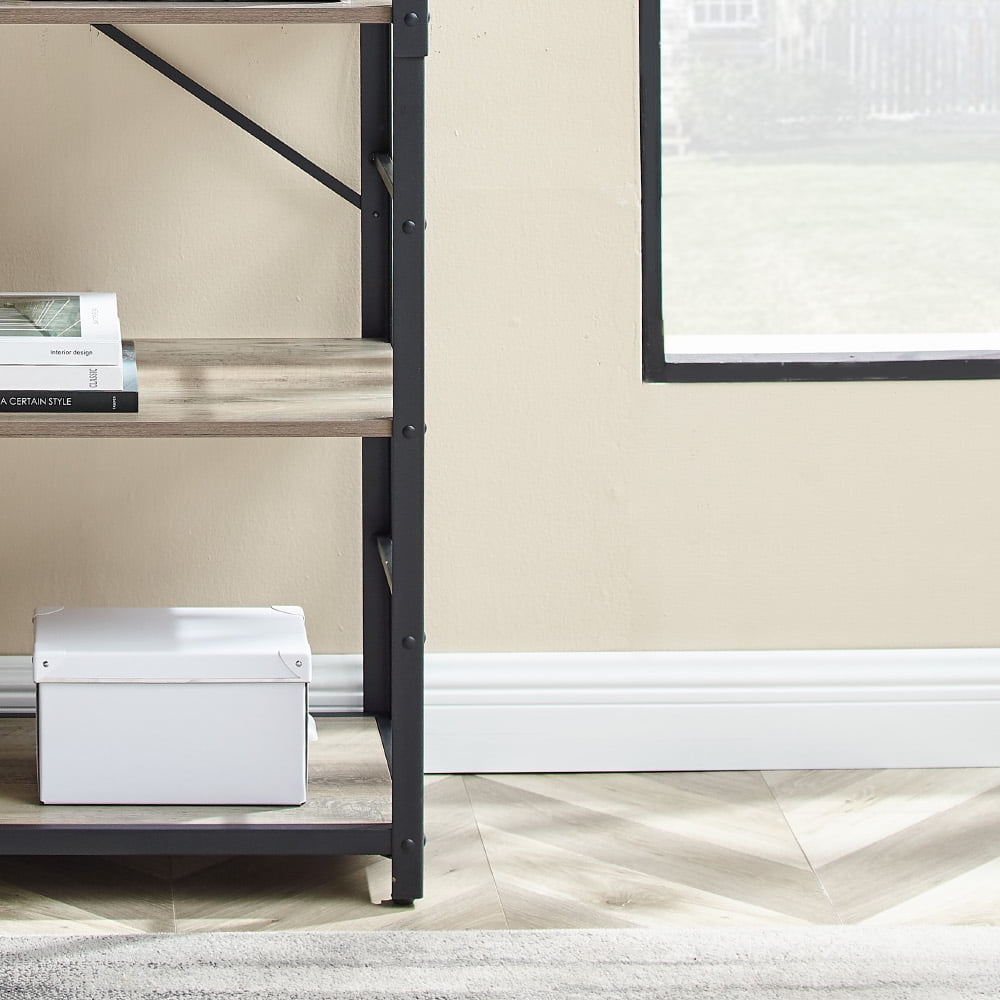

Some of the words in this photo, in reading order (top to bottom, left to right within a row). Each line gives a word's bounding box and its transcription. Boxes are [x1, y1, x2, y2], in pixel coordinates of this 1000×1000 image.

[0, 397, 7, 406] A
[9, 397, 47, 406] CERTAIN
[48, 397, 72, 406] STYLE
